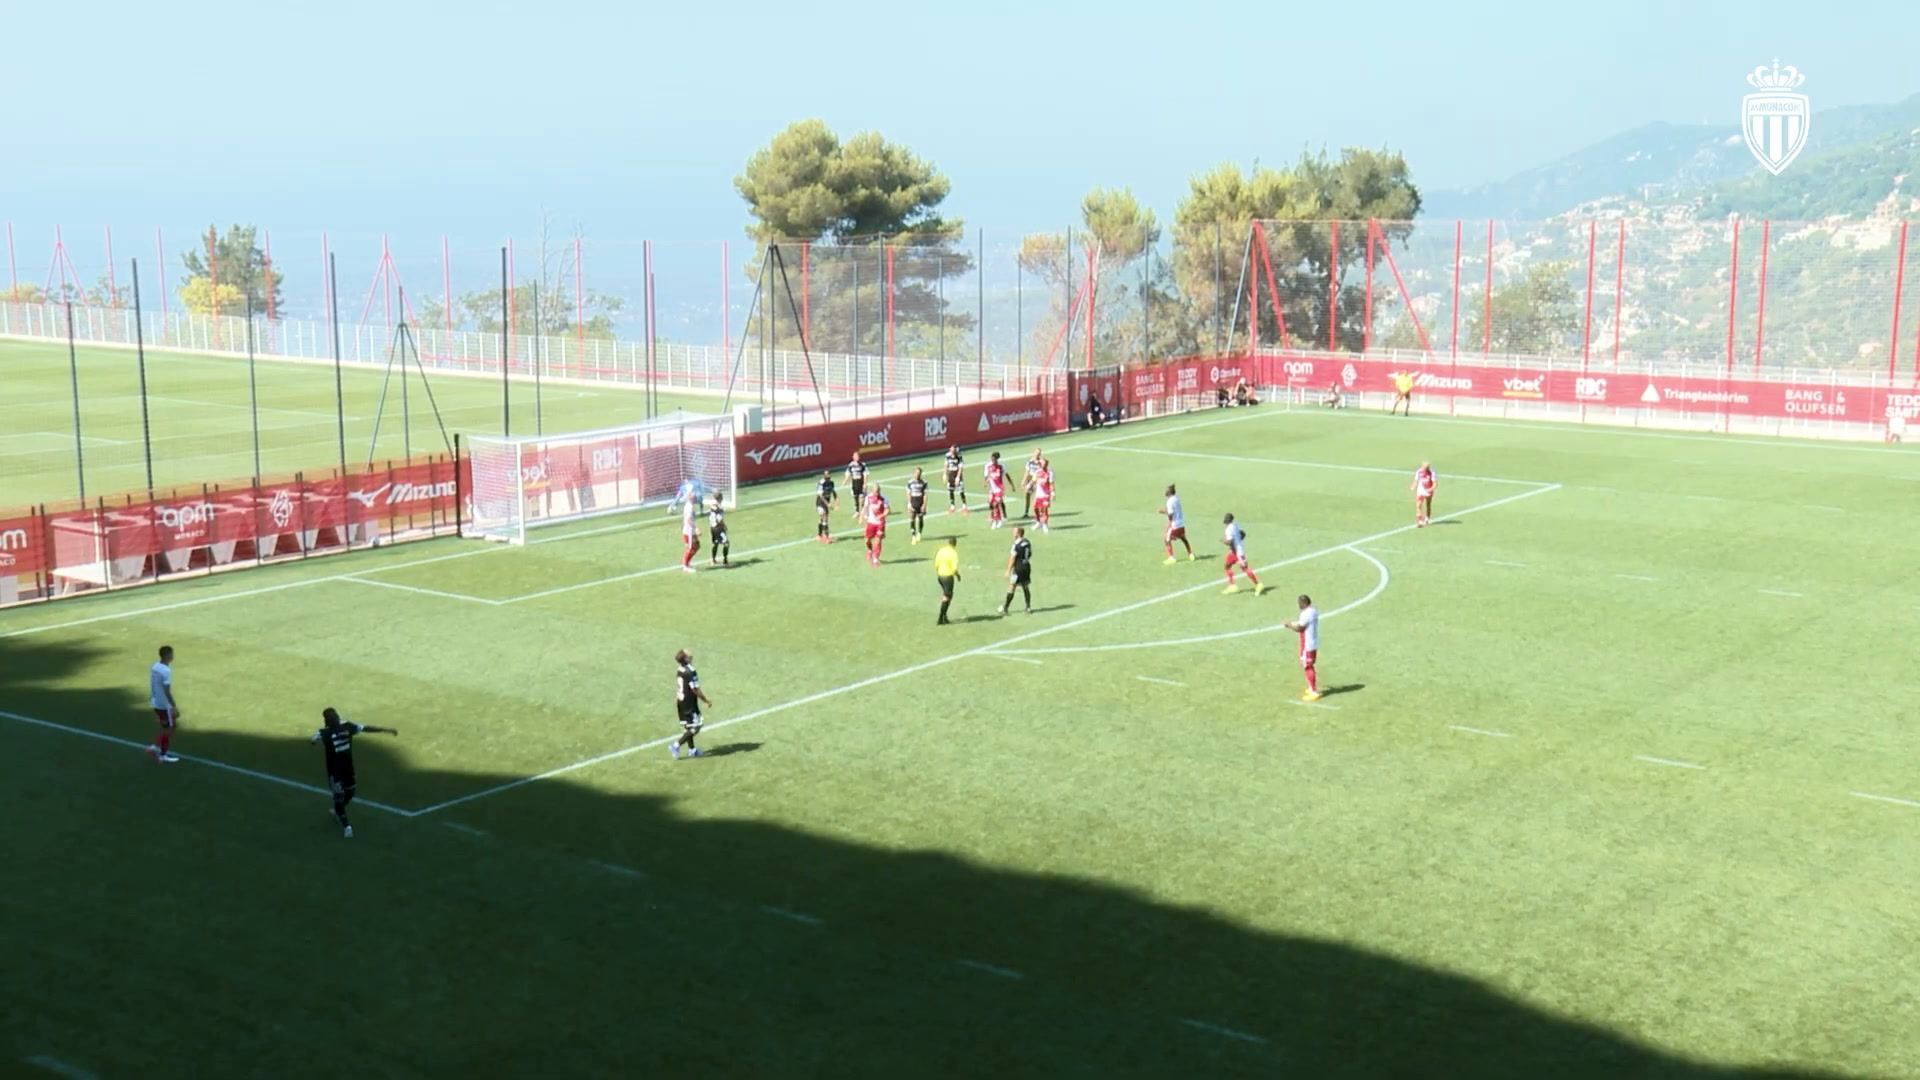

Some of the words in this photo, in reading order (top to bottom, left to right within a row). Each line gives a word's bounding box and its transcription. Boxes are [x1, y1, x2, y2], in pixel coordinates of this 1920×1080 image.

[1503, 375, 1541, 391] vbet
[1785, 389, 1823, 402] BANG
[1836, 391, 1846, 403] &
[1784, 401, 1846, 416] OLUFSEN
[859, 428, 890, 446] vbet
[162, 503, 215, 532] apm
